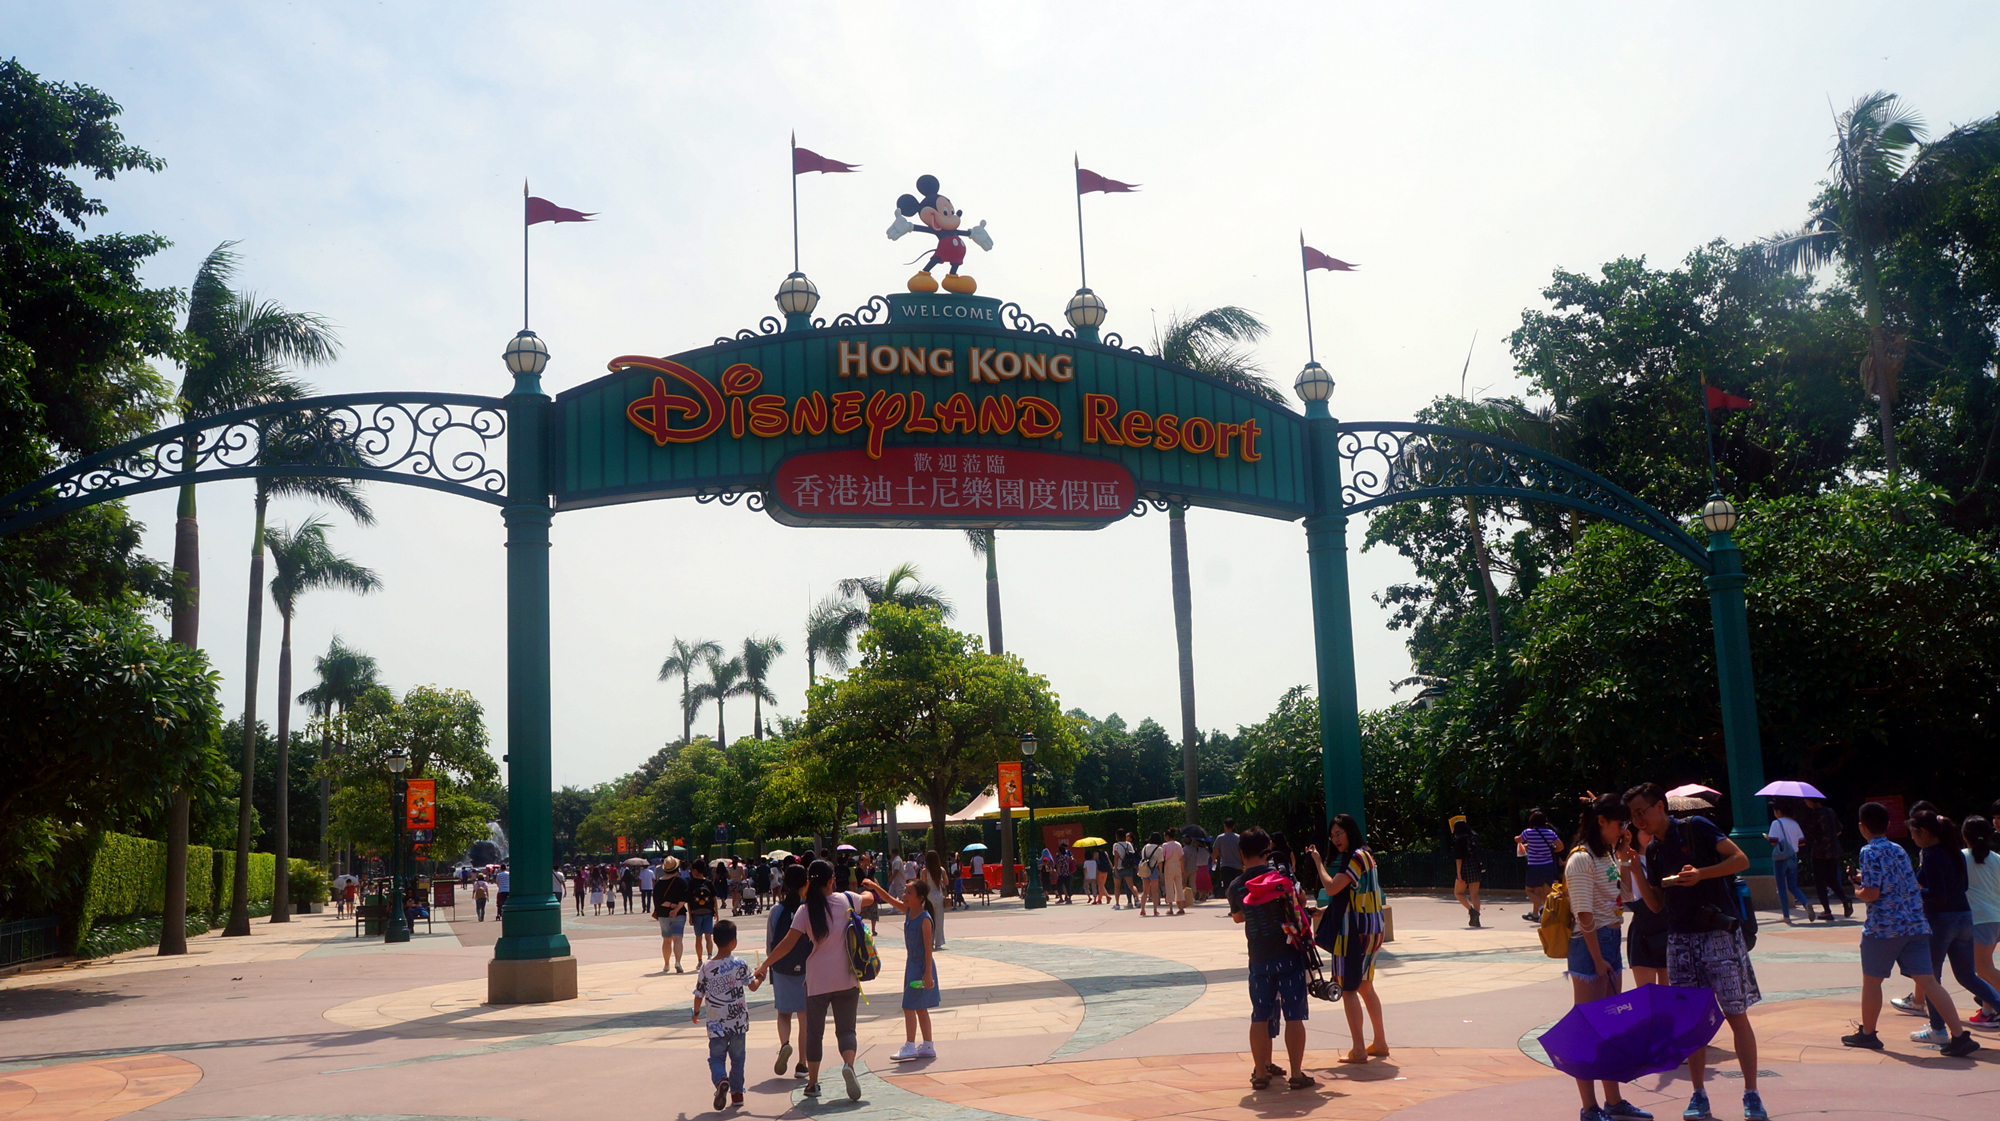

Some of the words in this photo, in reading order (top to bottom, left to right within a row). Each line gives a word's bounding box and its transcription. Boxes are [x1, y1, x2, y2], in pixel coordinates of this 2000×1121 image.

[901, 305, 994, 321] WELCOME
[838, 340, 954, 378] HONG
[968, 346, 1074, 384] KONG
[1083, 393, 1262, 463] Resort
[913, 452, 1006, 475] 歡迎蒞臨
[791, 474, 1122, 511] 香港迪士尼樂園度假區
